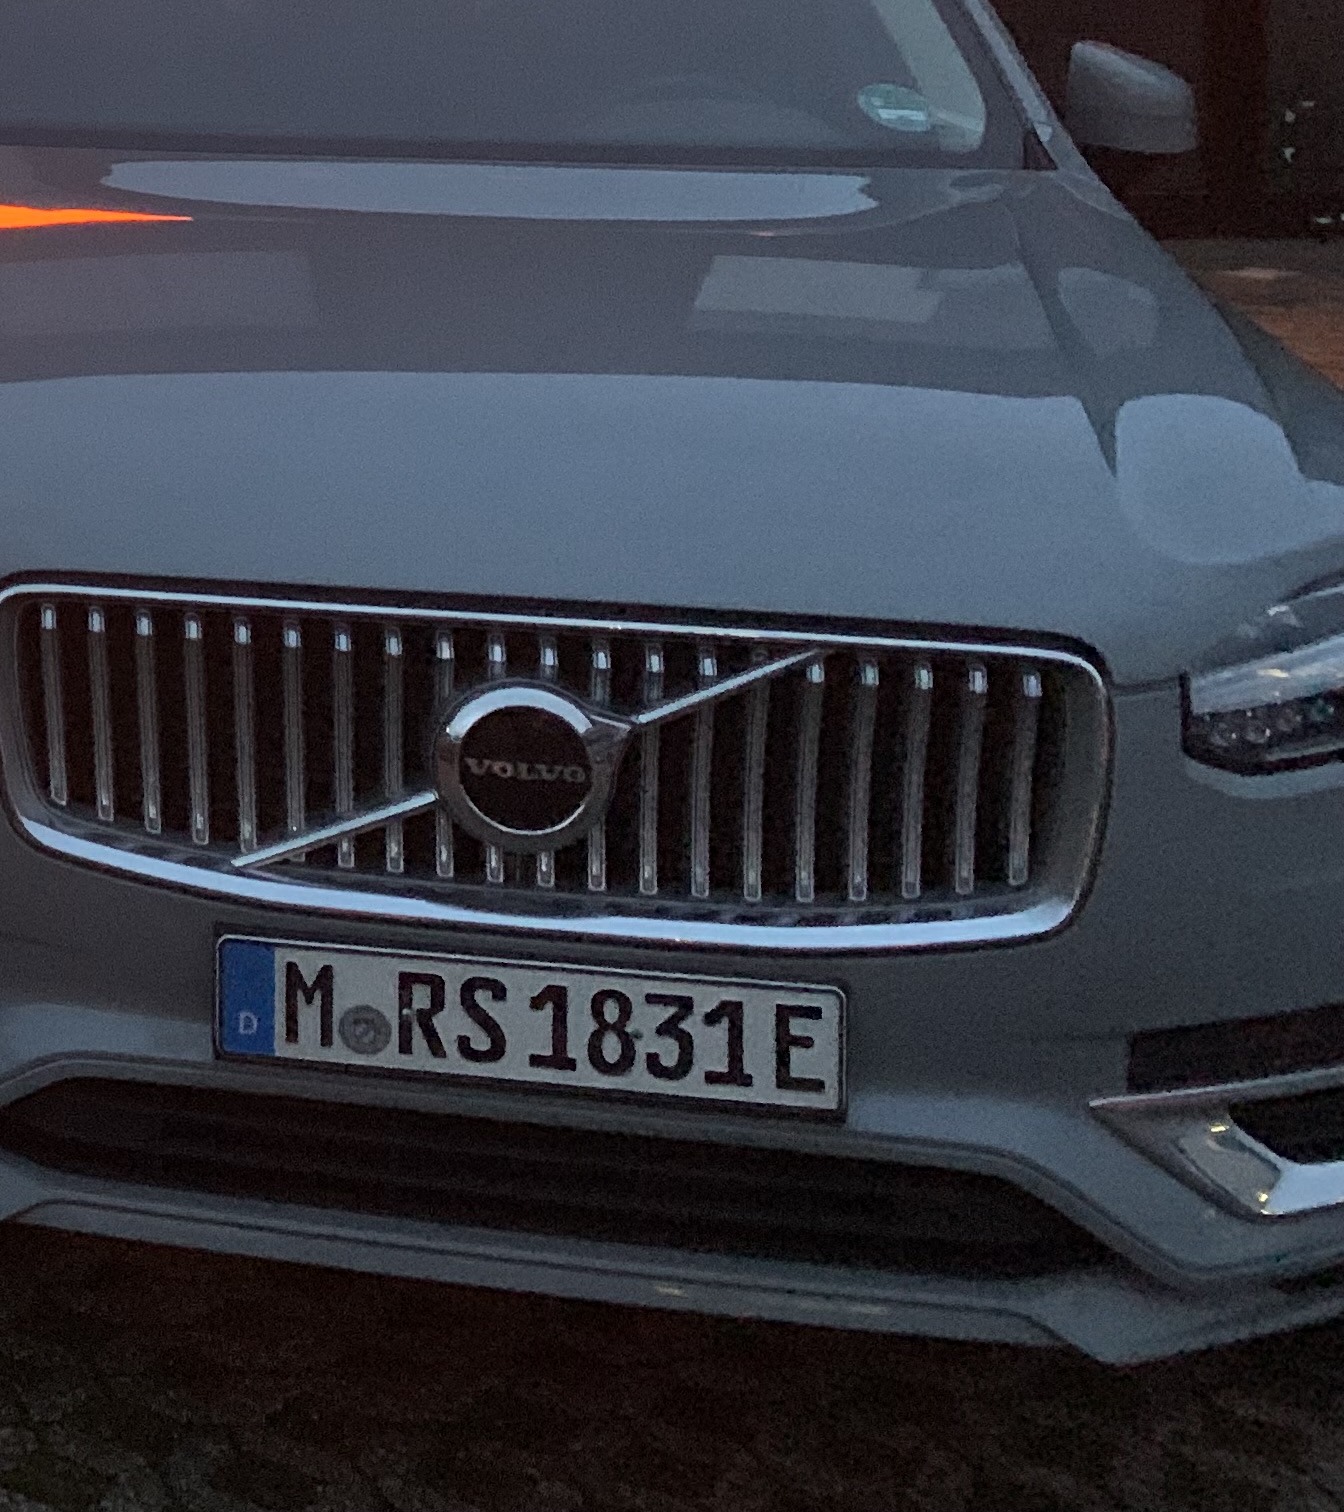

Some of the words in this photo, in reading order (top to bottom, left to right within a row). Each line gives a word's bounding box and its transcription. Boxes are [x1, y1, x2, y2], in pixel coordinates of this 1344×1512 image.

[464, 757, 587, 783] VOLVO
[284, 960, 334, 1048] M
[238, 1011, 258, 1035] D
